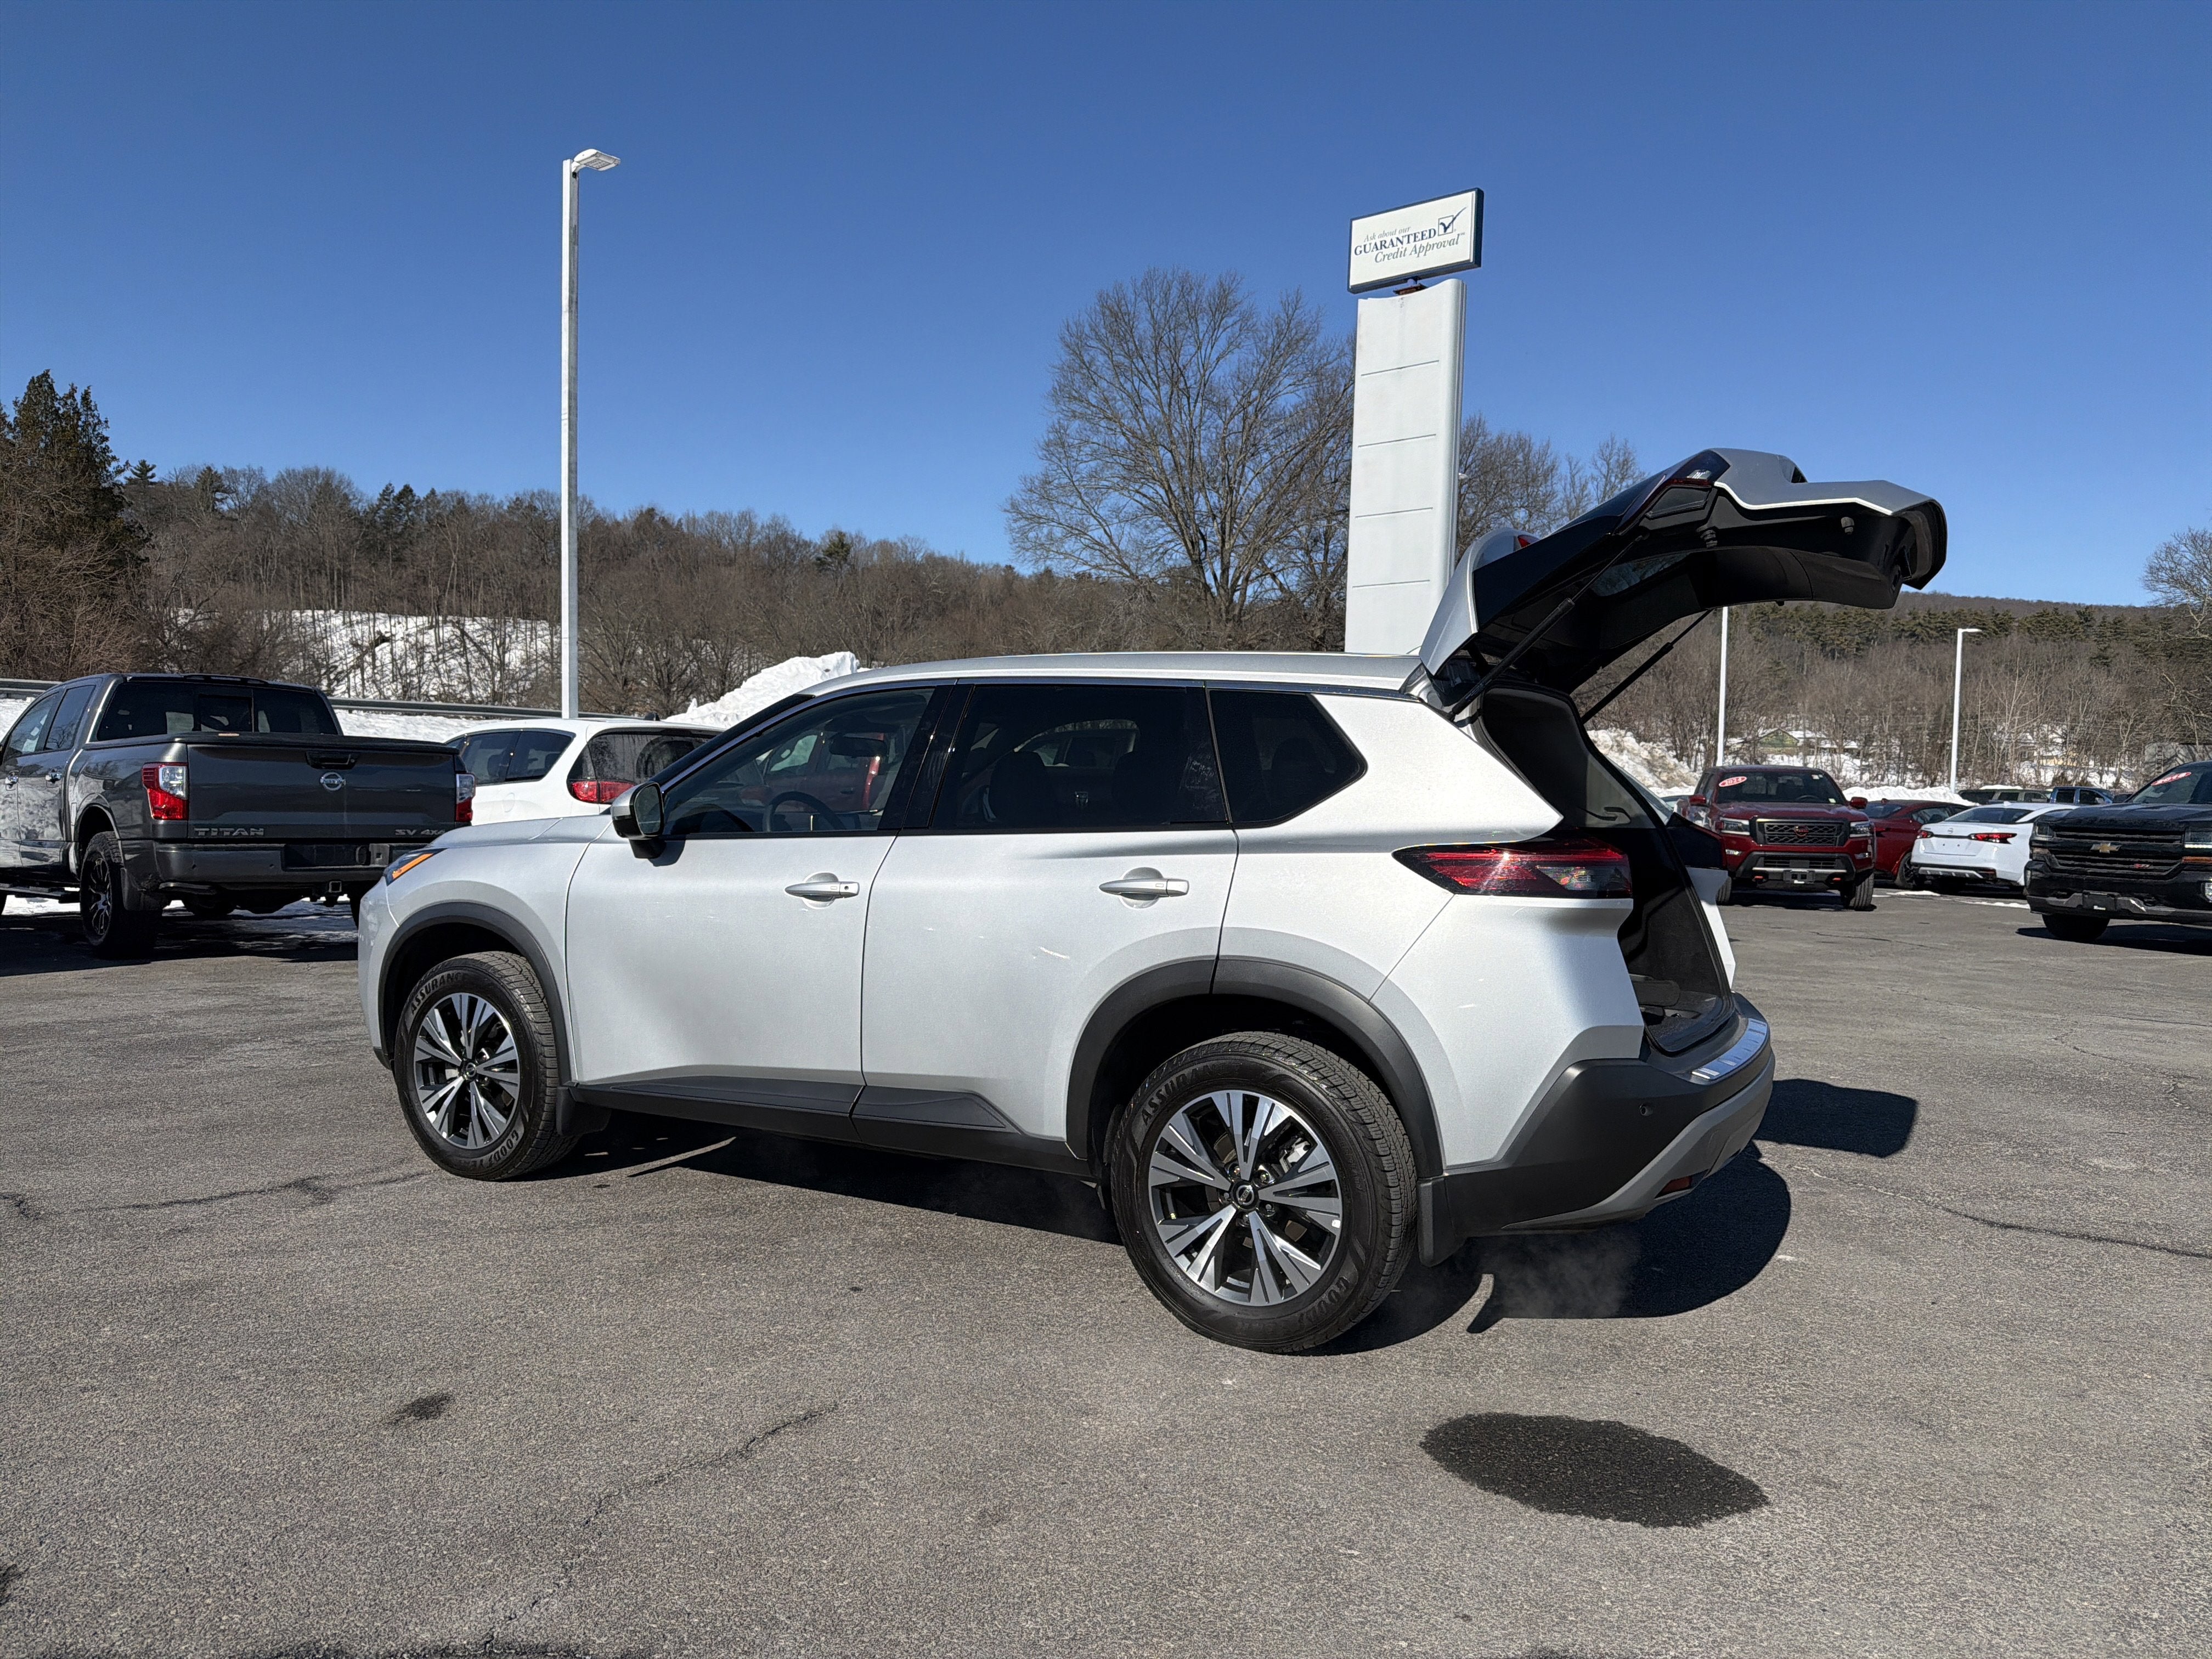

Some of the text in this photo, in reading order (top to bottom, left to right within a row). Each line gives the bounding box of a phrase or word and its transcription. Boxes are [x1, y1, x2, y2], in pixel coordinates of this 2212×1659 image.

[1354, 228, 1436, 256] GUARANTEED
[1363, 227, 1411, 242] Ask about our
[1374, 234, 1459, 263] Credit Approval
[194, 828, 264, 836] TITAN
[1141, 1062, 1241, 1125] ASSURAN
[459, 1130, 519, 1169] GOODYE
